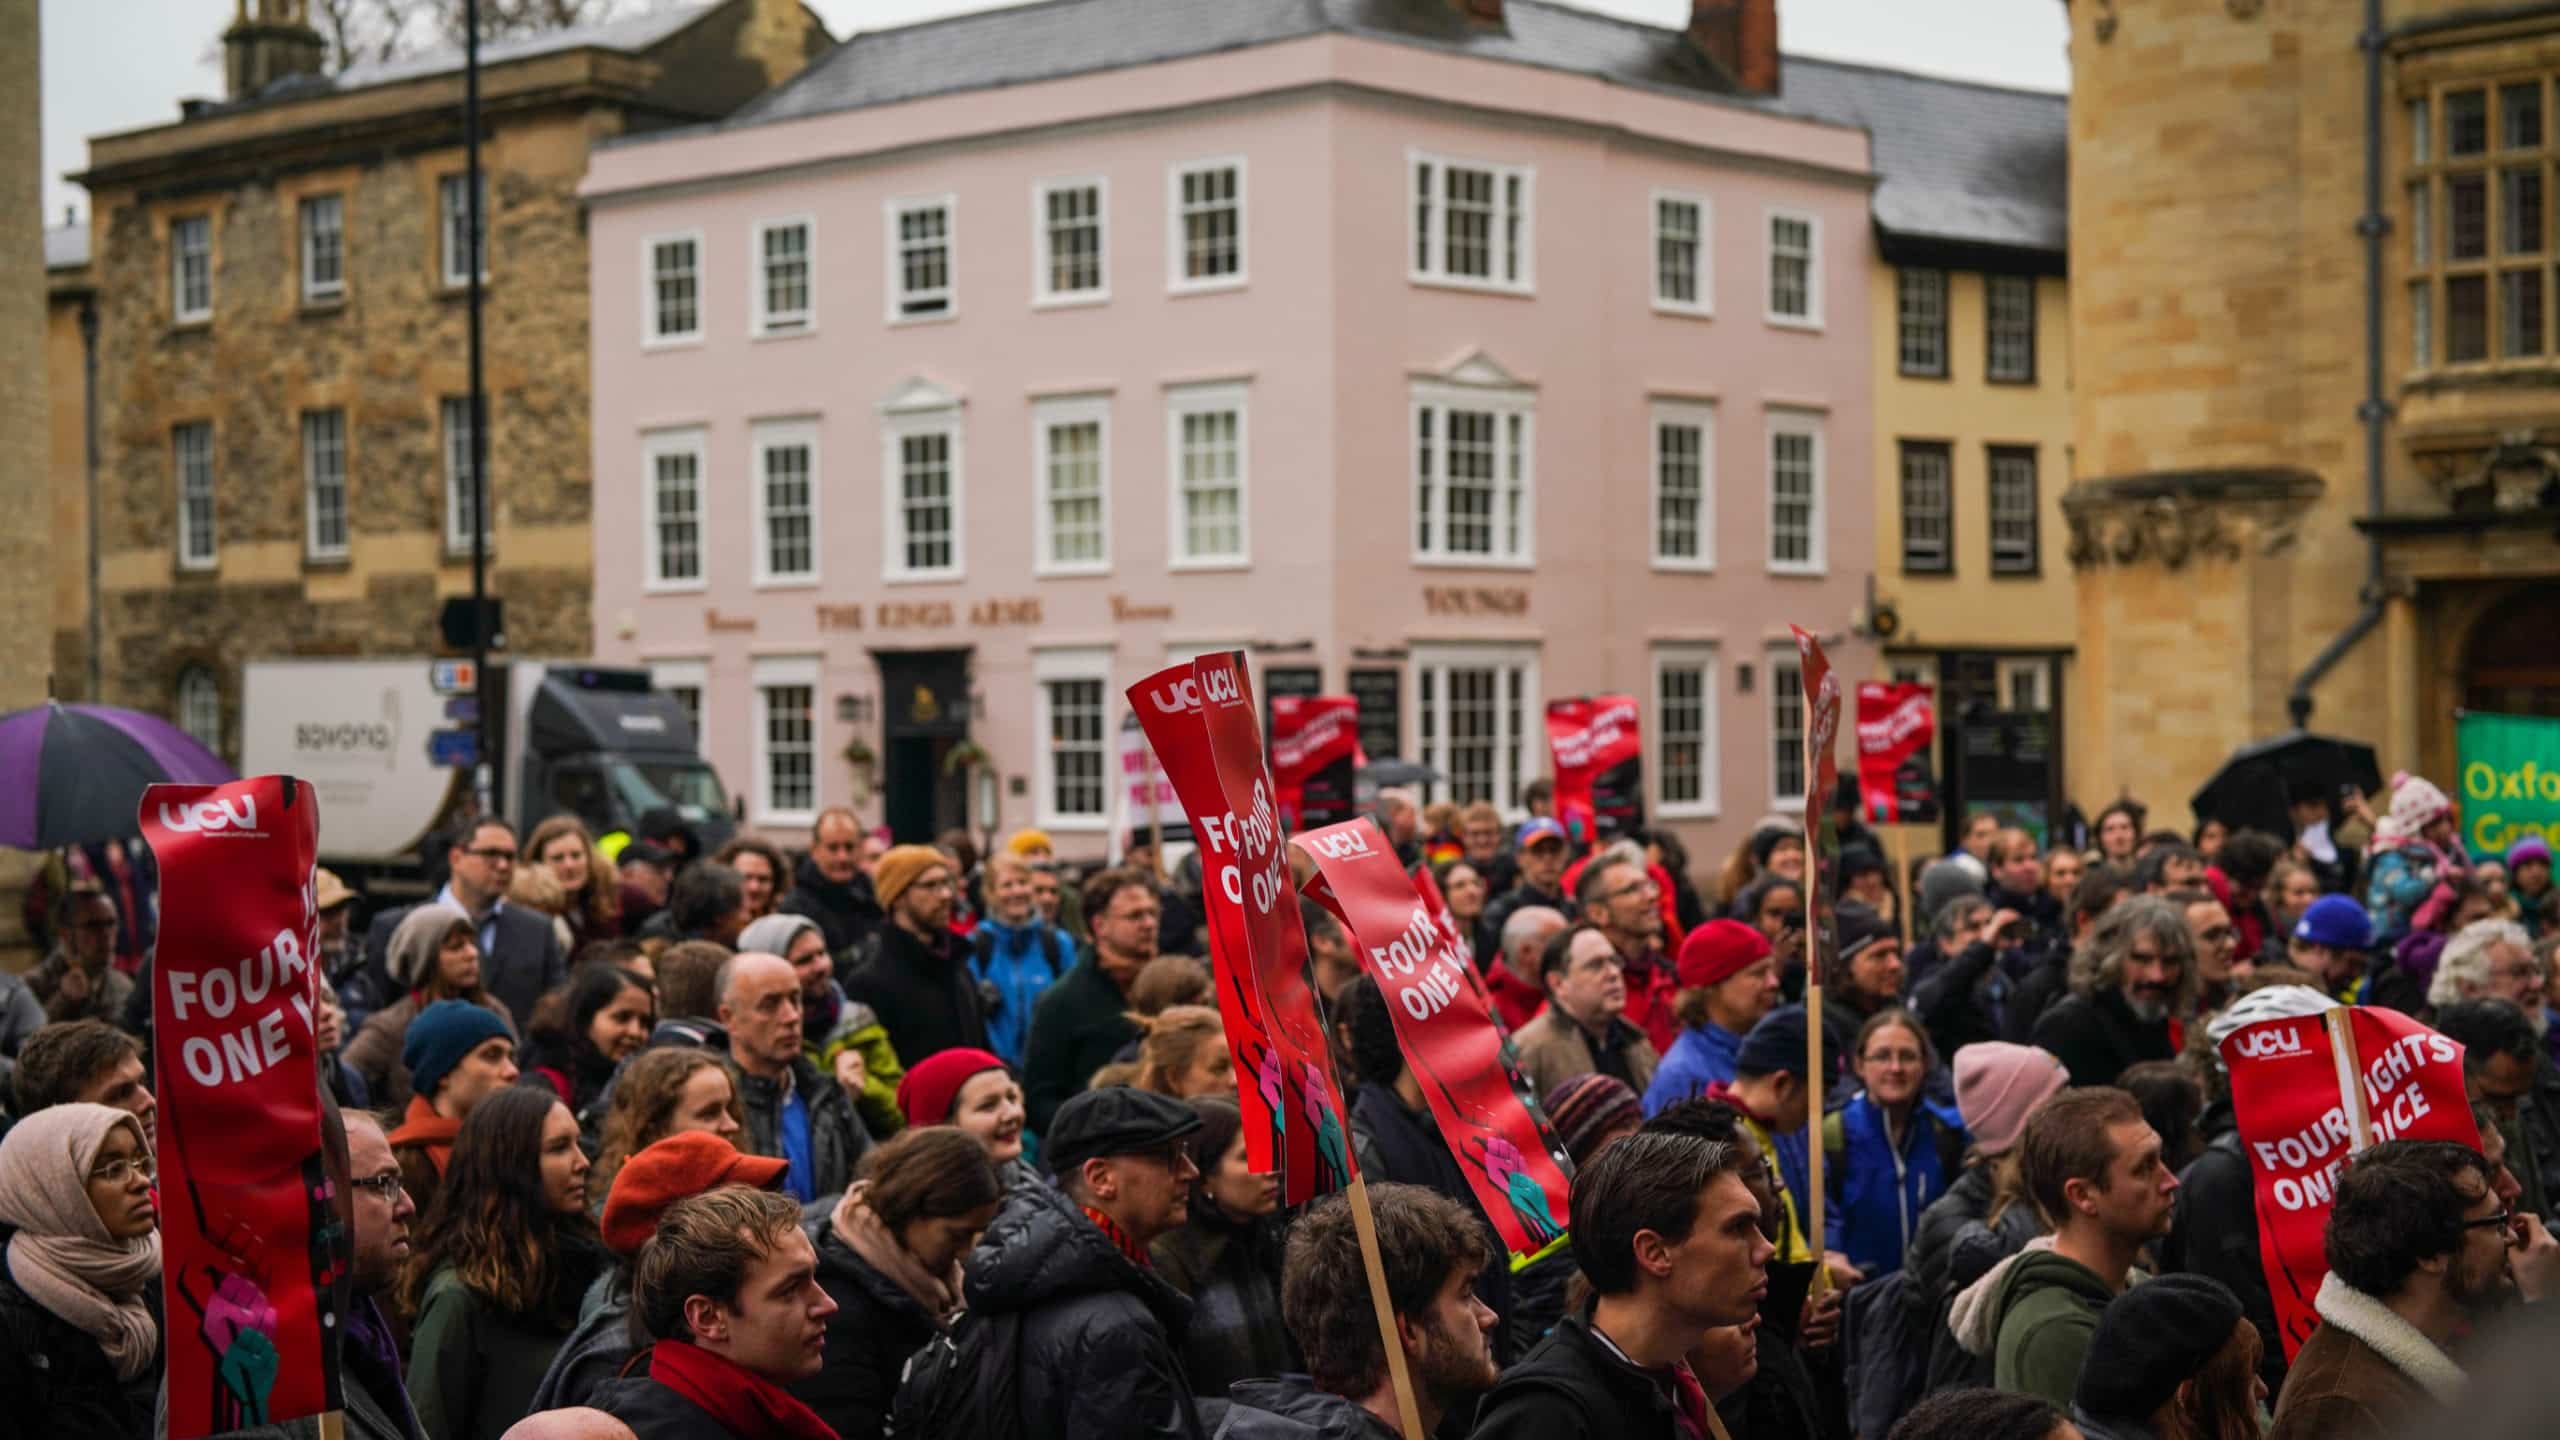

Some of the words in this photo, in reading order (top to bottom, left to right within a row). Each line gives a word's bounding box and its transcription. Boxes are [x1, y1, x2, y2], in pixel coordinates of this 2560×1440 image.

[1150, 678, 1201, 713] UC
[1202, 668, 1239, 702] UCU
[159, 794, 257, 832] UCU
[1200, 810, 1239, 854] FO
[1239, 778, 1272, 860] FOUR
[1311, 829, 1368, 858] UCU
[1252, 846, 1282, 914] ONE
[1371, 908, 1438, 980] FOUR
[167, 927, 306, 1021] FOUR
[1400, 963, 1460, 1021] ONE
[182, 1007, 291, 1087] ONE
[2234, 1027, 2301, 1057] UCU
[2253, 1107, 2350, 1171] FOUR
[2363, 1033, 2456, 1106] IGHTS
